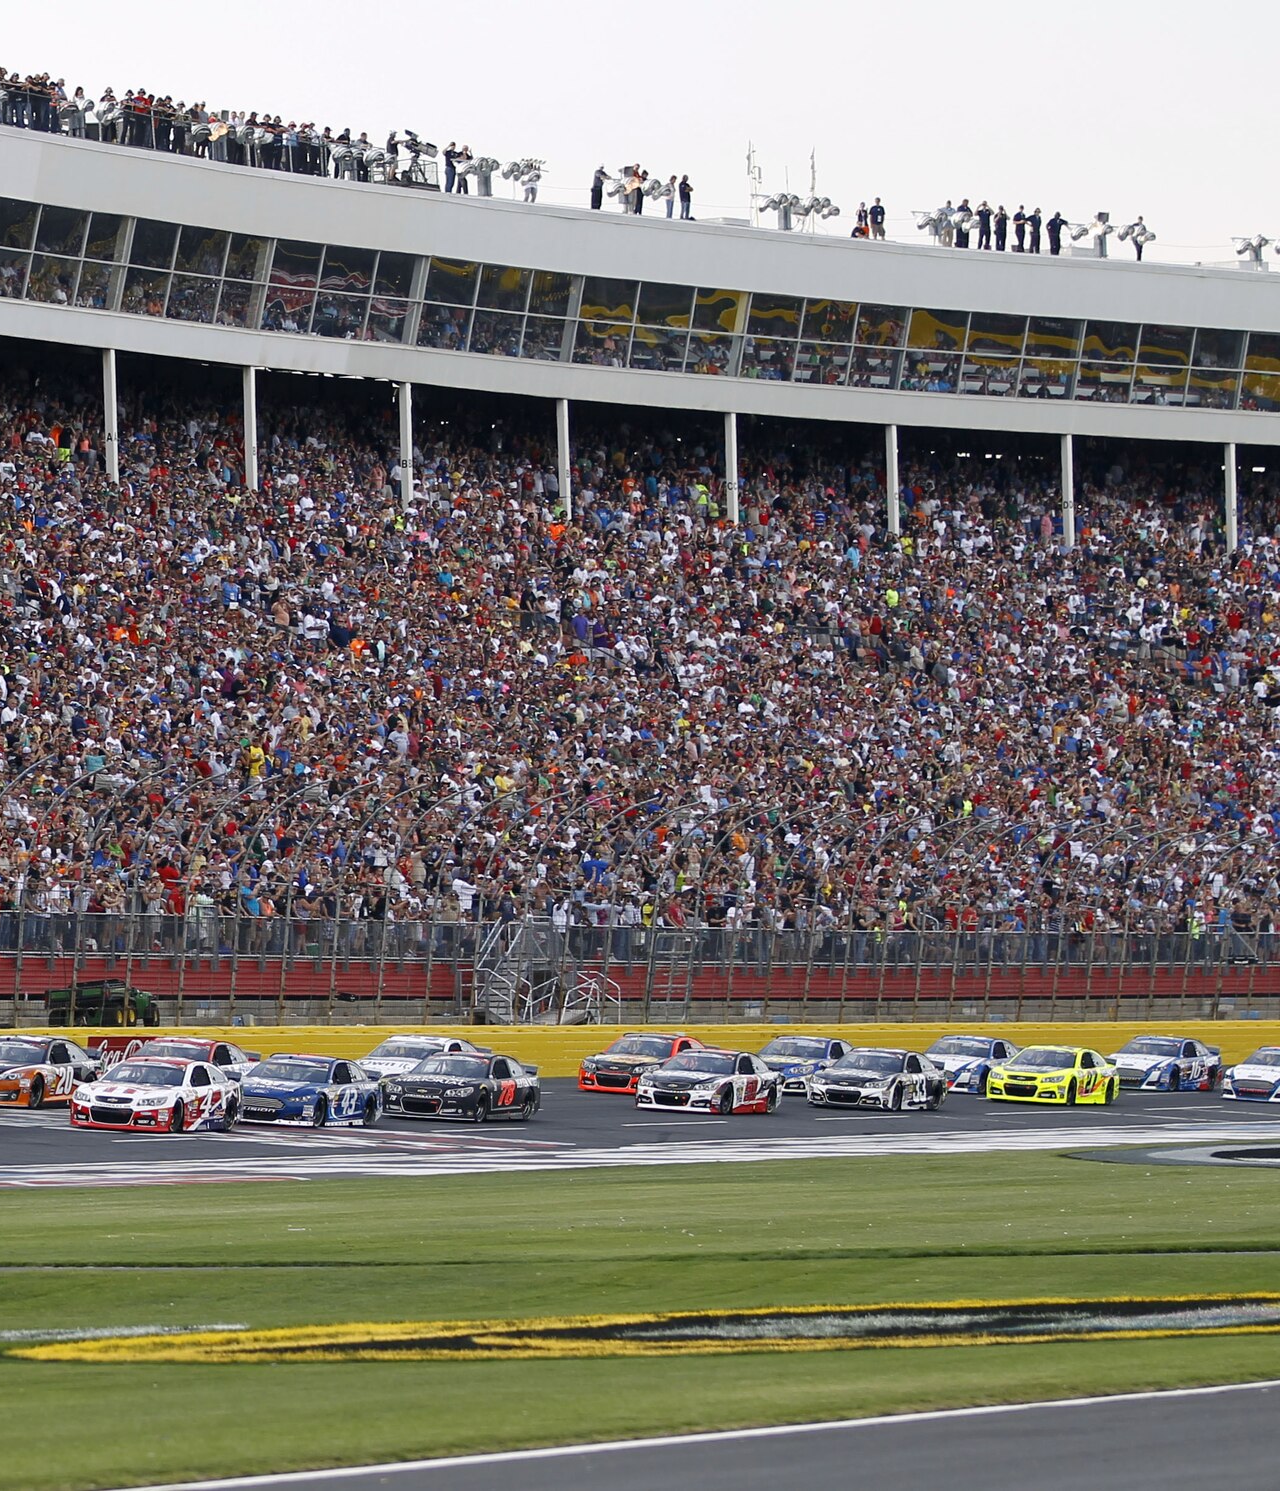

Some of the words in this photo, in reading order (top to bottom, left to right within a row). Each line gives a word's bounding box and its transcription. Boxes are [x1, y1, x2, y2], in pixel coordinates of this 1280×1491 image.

[106, 433, 112, 442] A
[401, 460, 408, 468] B
[726, 482, 733, 491] C
[1062, 501, 1068, 509] D
[55, 1066, 74, 1095] 20
[1190, 1060, 1201, 1080] 16
[497, 1079, 516, 1107] 78
[912, 1073, 927, 1102] 33
[199, 1088, 214, 1120] 4
[341, 1088, 358, 1116] 43
